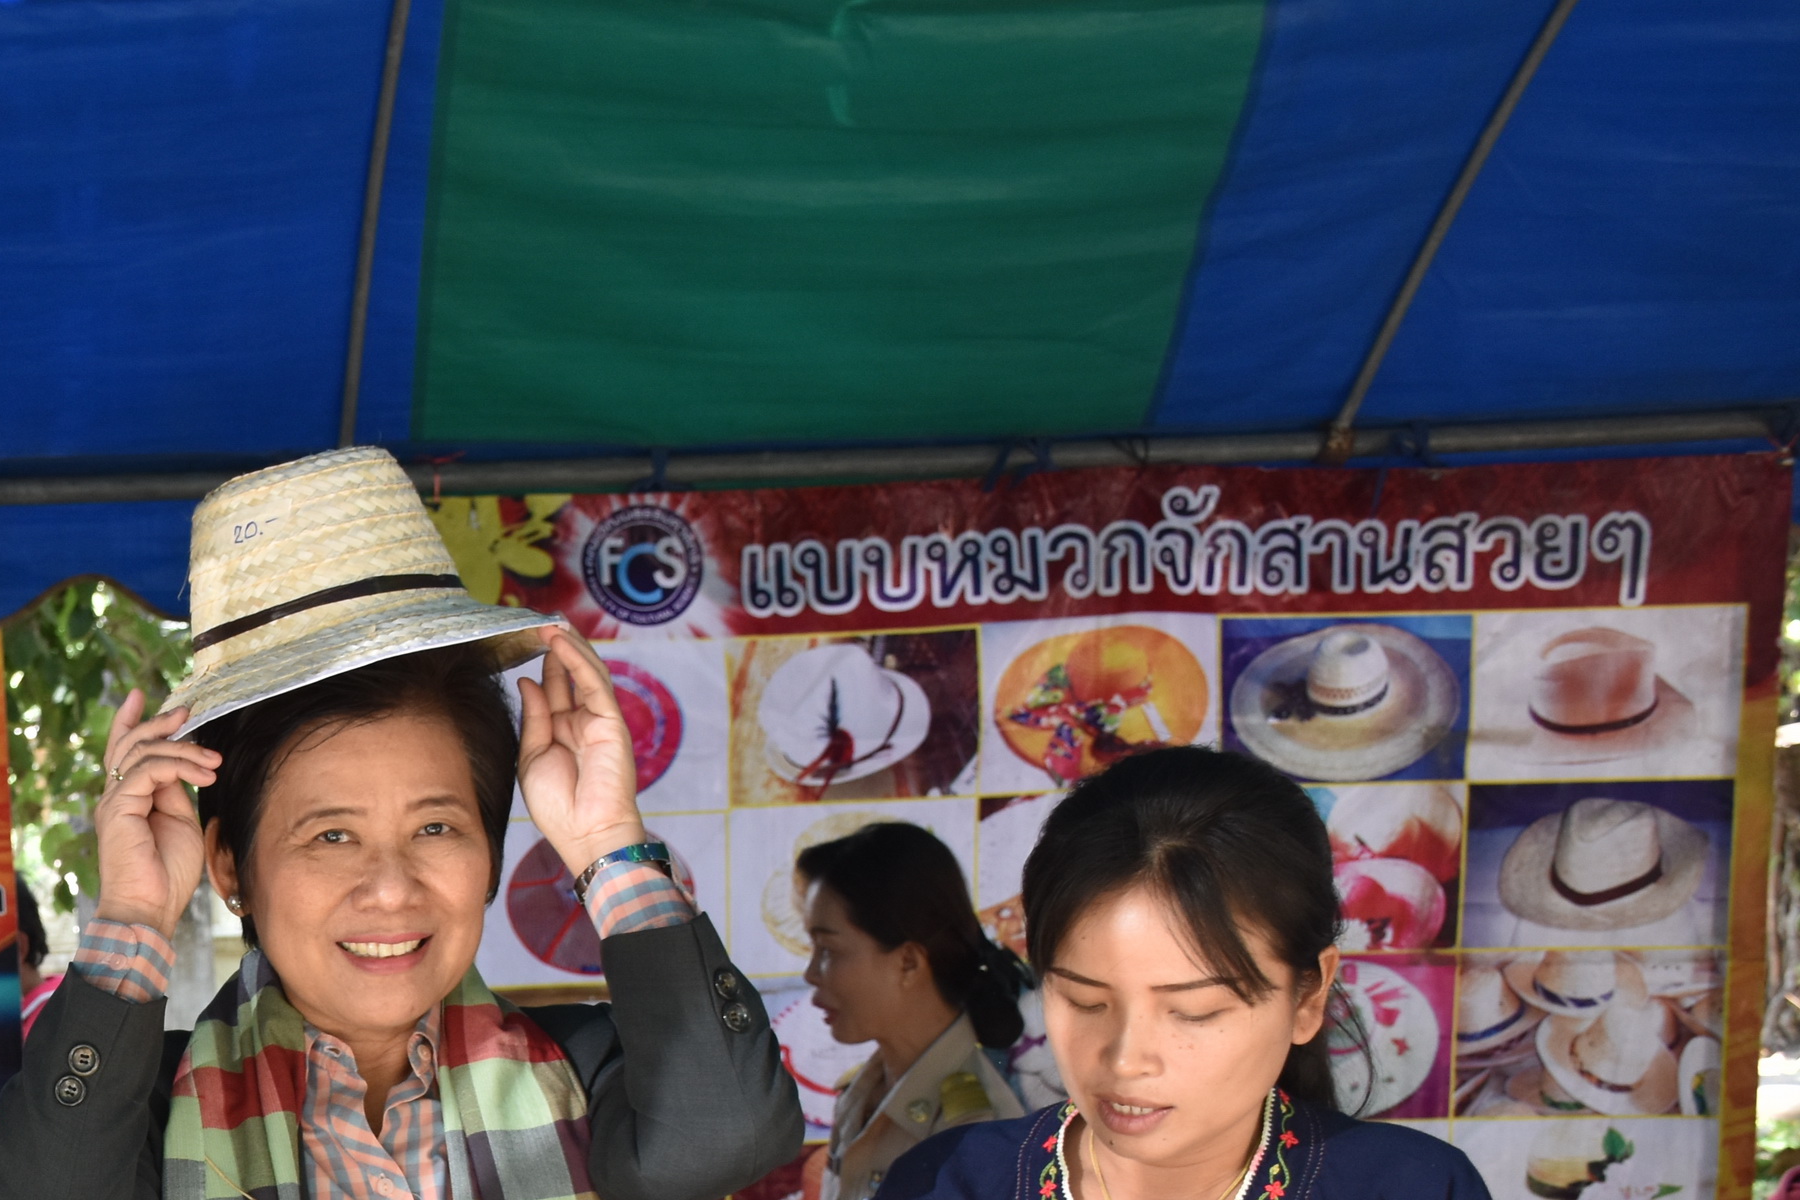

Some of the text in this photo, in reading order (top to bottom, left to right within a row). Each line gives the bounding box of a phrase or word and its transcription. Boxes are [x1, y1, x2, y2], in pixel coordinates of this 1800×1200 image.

[598, 535, 688, 605] FCS
[743, 486, 1650, 617] แบบหมวกจักสานสวยๆ
